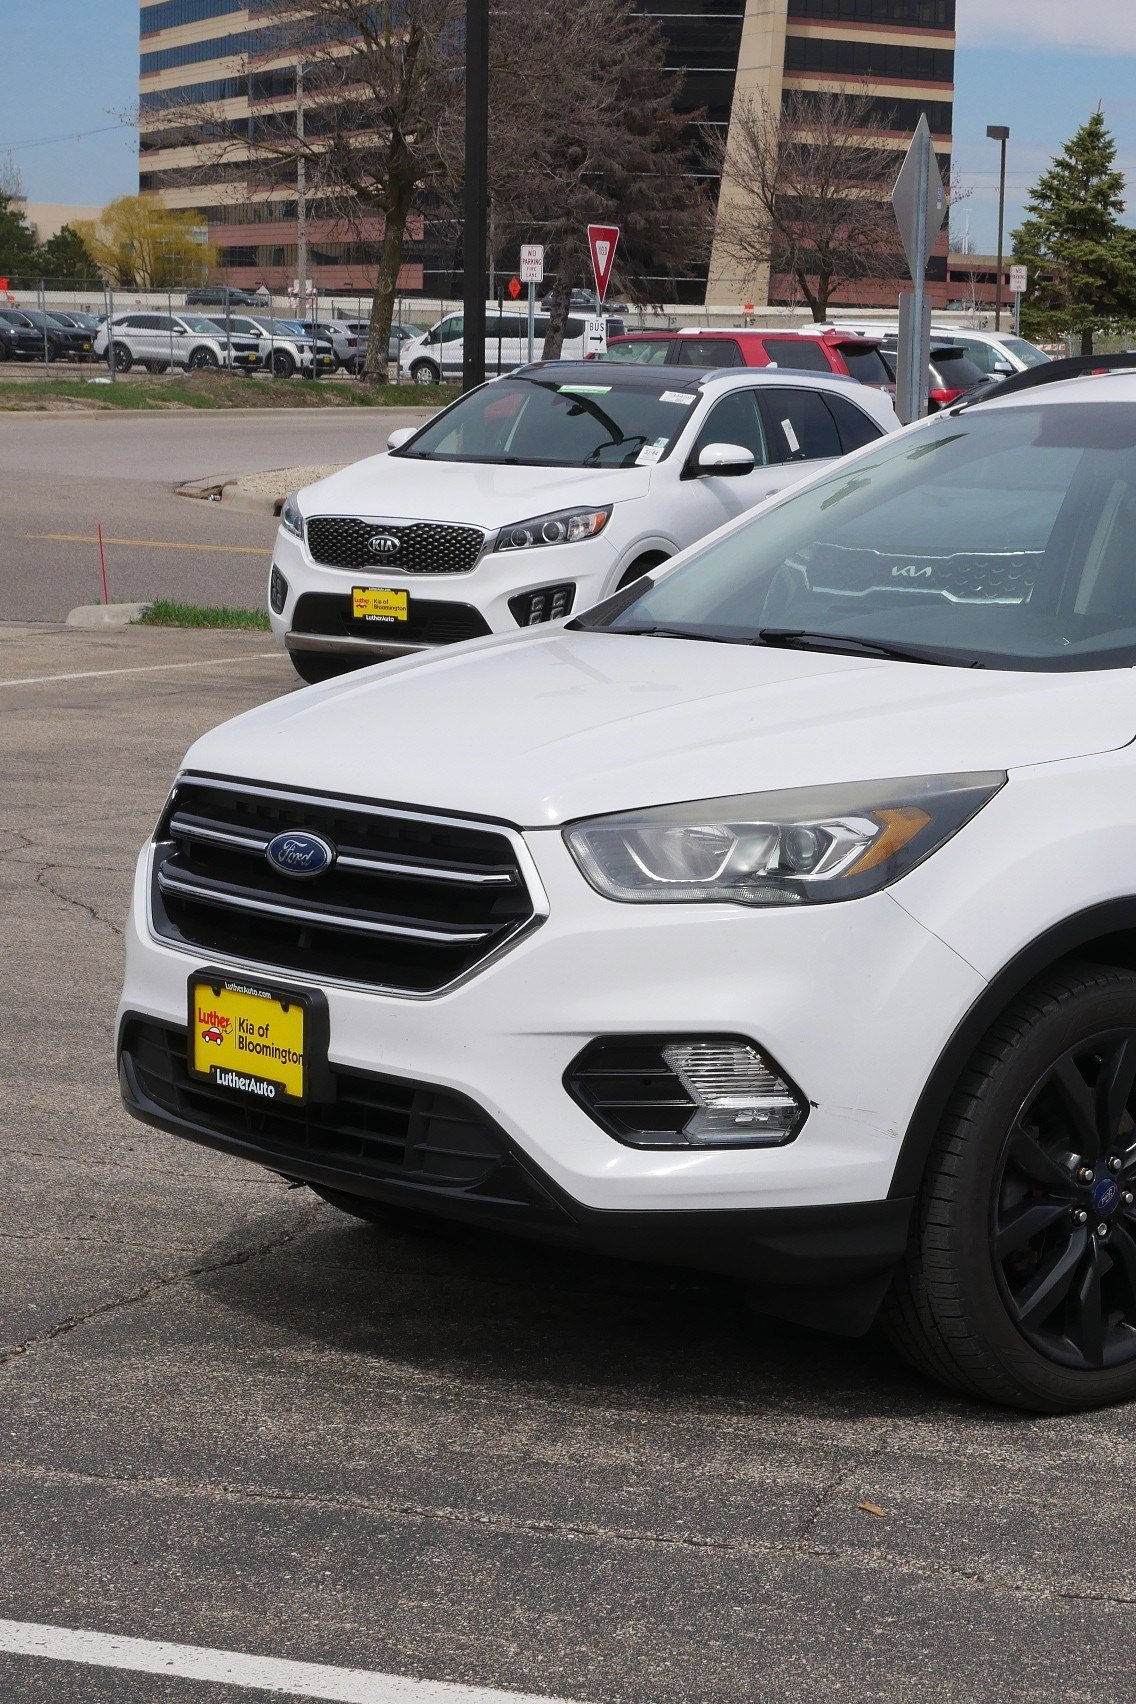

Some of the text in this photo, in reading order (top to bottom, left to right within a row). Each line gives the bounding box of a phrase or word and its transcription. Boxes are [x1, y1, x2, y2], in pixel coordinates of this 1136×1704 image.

[527, 249, 538, 258] NO
[522, 258, 542, 266] PARKING
[589, 322, 605, 332] BUS
[372, 539, 394, 551] KIA
[373, 603, 407, 612] Bloomington
[365, 614, 395, 622] LutherAuto
[278, 839, 315, 867] Ford
[224, 981, 272, 999] LutherAuto.com
[198, 1007, 231, 1029] Luther
[238, 1017, 270, 1039] Kia of
[238, 1034, 303, 1066] Bloomington
[216, 1068, 276, 1098] LutherAuto
